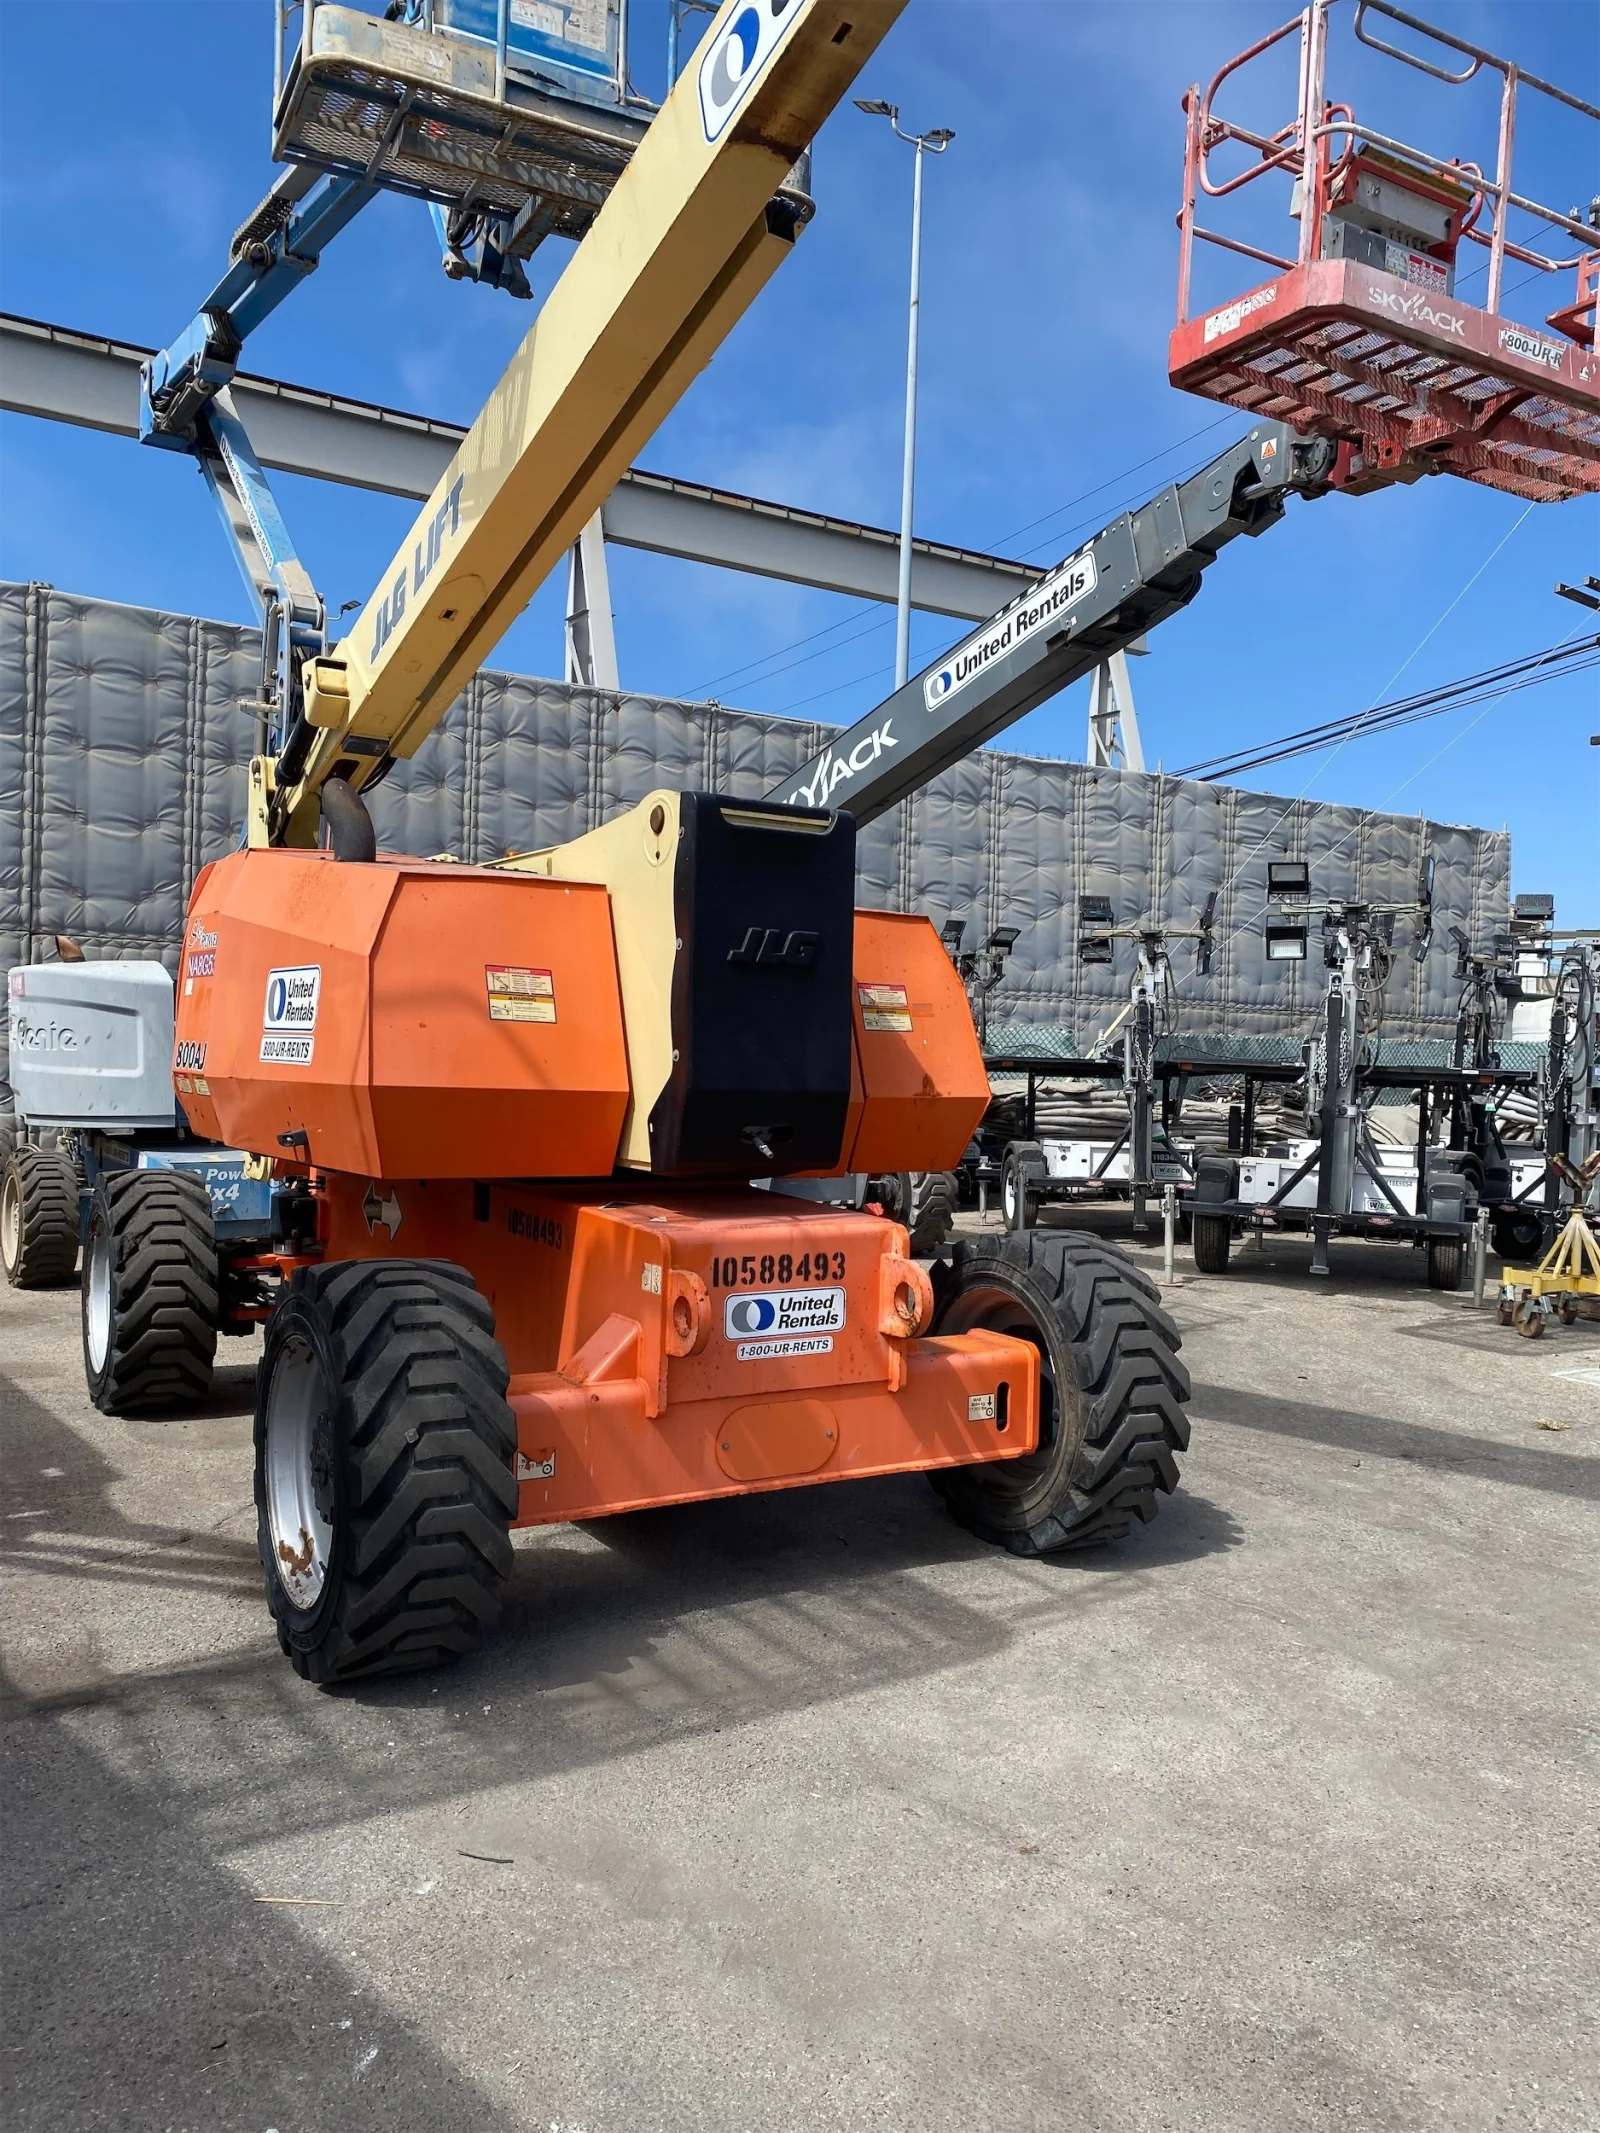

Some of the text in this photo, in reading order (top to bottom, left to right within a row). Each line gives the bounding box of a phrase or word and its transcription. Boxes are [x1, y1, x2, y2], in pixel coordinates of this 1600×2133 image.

[1369, 287, 1465, 336] SKYJACK
[371, 470, 465, 665] JLG LIFT
[956, 572, 1085, 682] United Rentals
[781, 718, 899, 808] YJACK
[726, 926, 821, 965] JLG
[288, 977, 316, 998] United
[285, 1001, 314, 1022] Rentals
[263, 1041, 310, 1059] 800-UR-RENTS
[712, 1252, 846, 1288] 10588493
[779, 1294, 835, 1313] United
[778, 1310, 839, 1330] Rentals
[740, 1339, 829, 1357] 1-800-UR-RENTS
